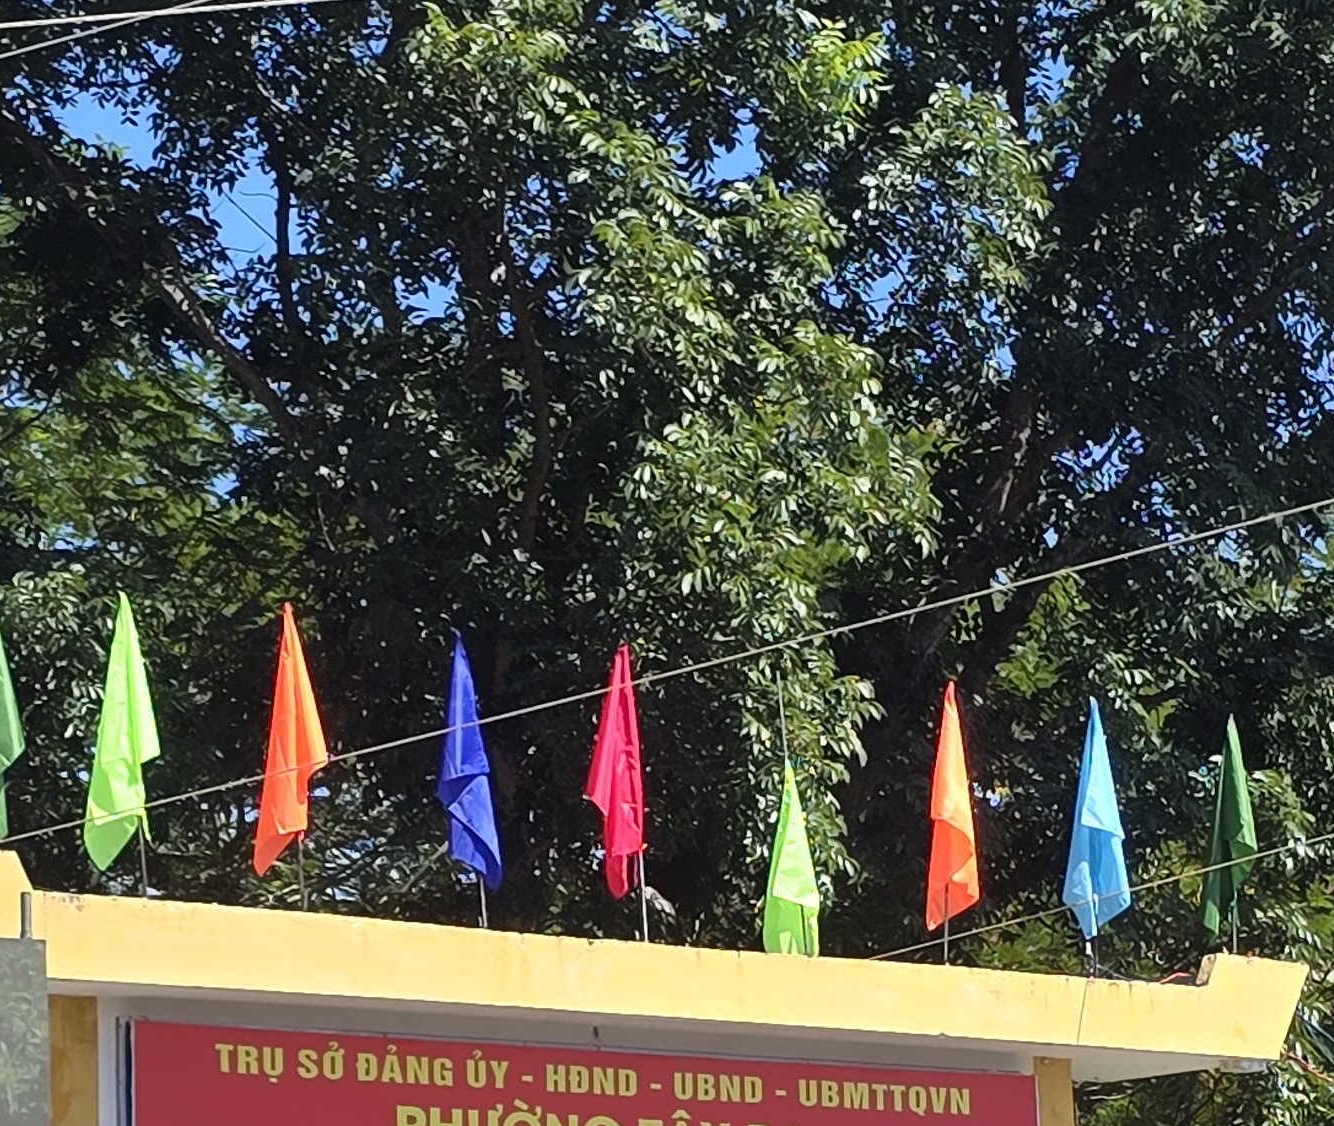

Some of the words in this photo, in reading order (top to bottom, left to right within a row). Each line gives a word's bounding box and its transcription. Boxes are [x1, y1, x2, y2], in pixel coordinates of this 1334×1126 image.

[215, 1043, 284, 1082] TRỤ
[297, 1042, 346, 1080] SỞ
[355, 1045, 454, 1089] ĐẢNG
[466, 1050, 509, 1089] ỦY
[546, 1064, 638, 1097] HĐND
[673, 1072, 763, 1104] UBND
[798, 1079, 972, 1115] UBMTTQVN
